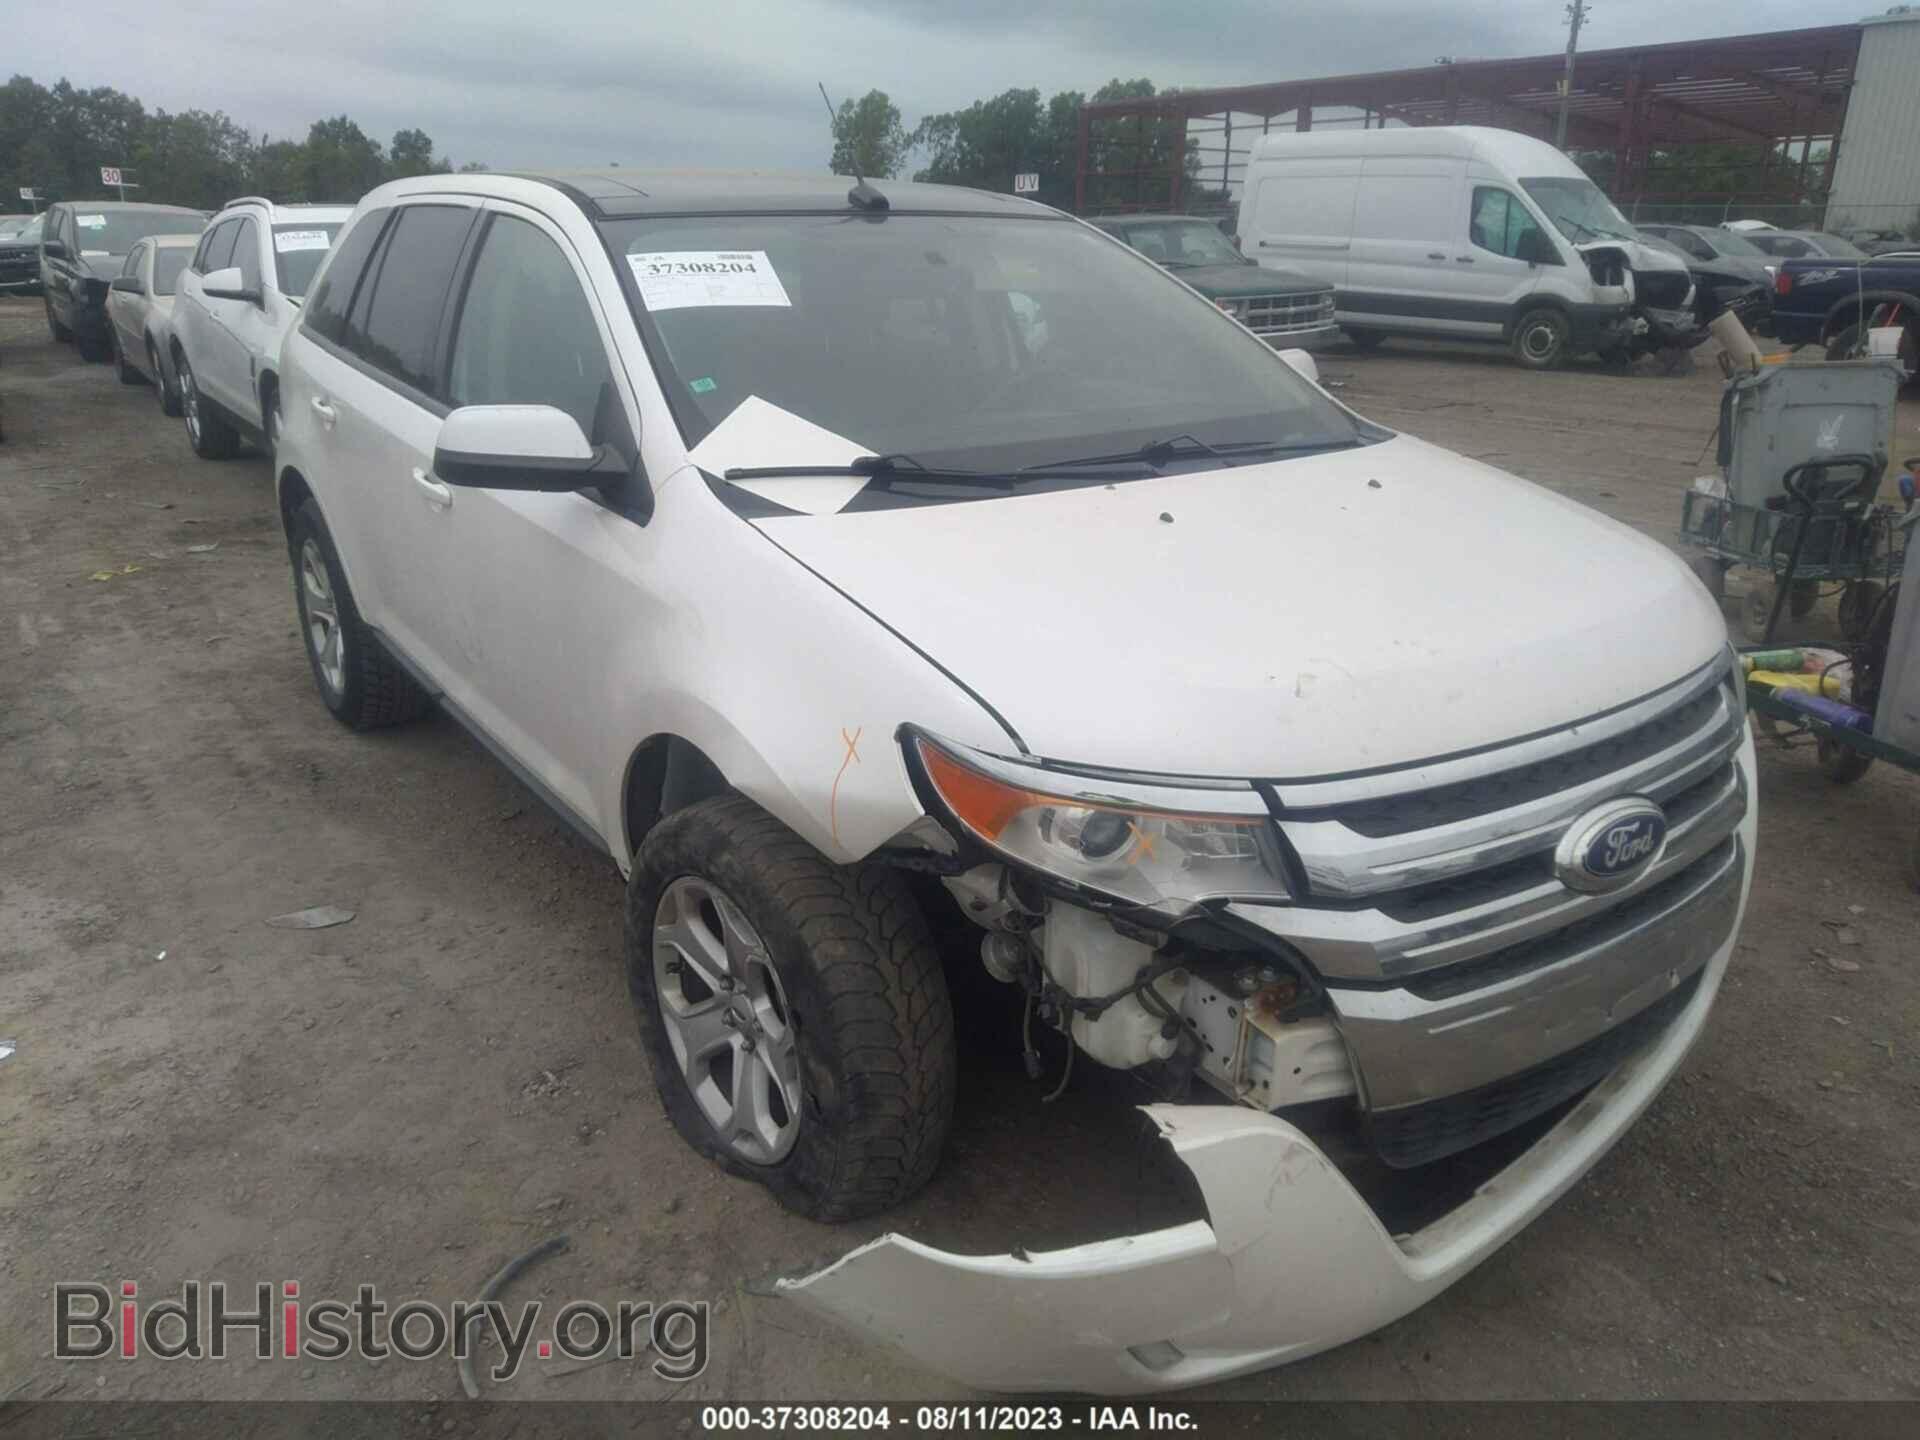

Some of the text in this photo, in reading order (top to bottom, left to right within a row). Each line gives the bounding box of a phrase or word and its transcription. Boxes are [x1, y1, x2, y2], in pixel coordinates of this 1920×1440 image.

[103, 168, 120, 183] 30
[647, 261, 757, 276] 37308204
[1604, 820, 1654, 868] Ford
